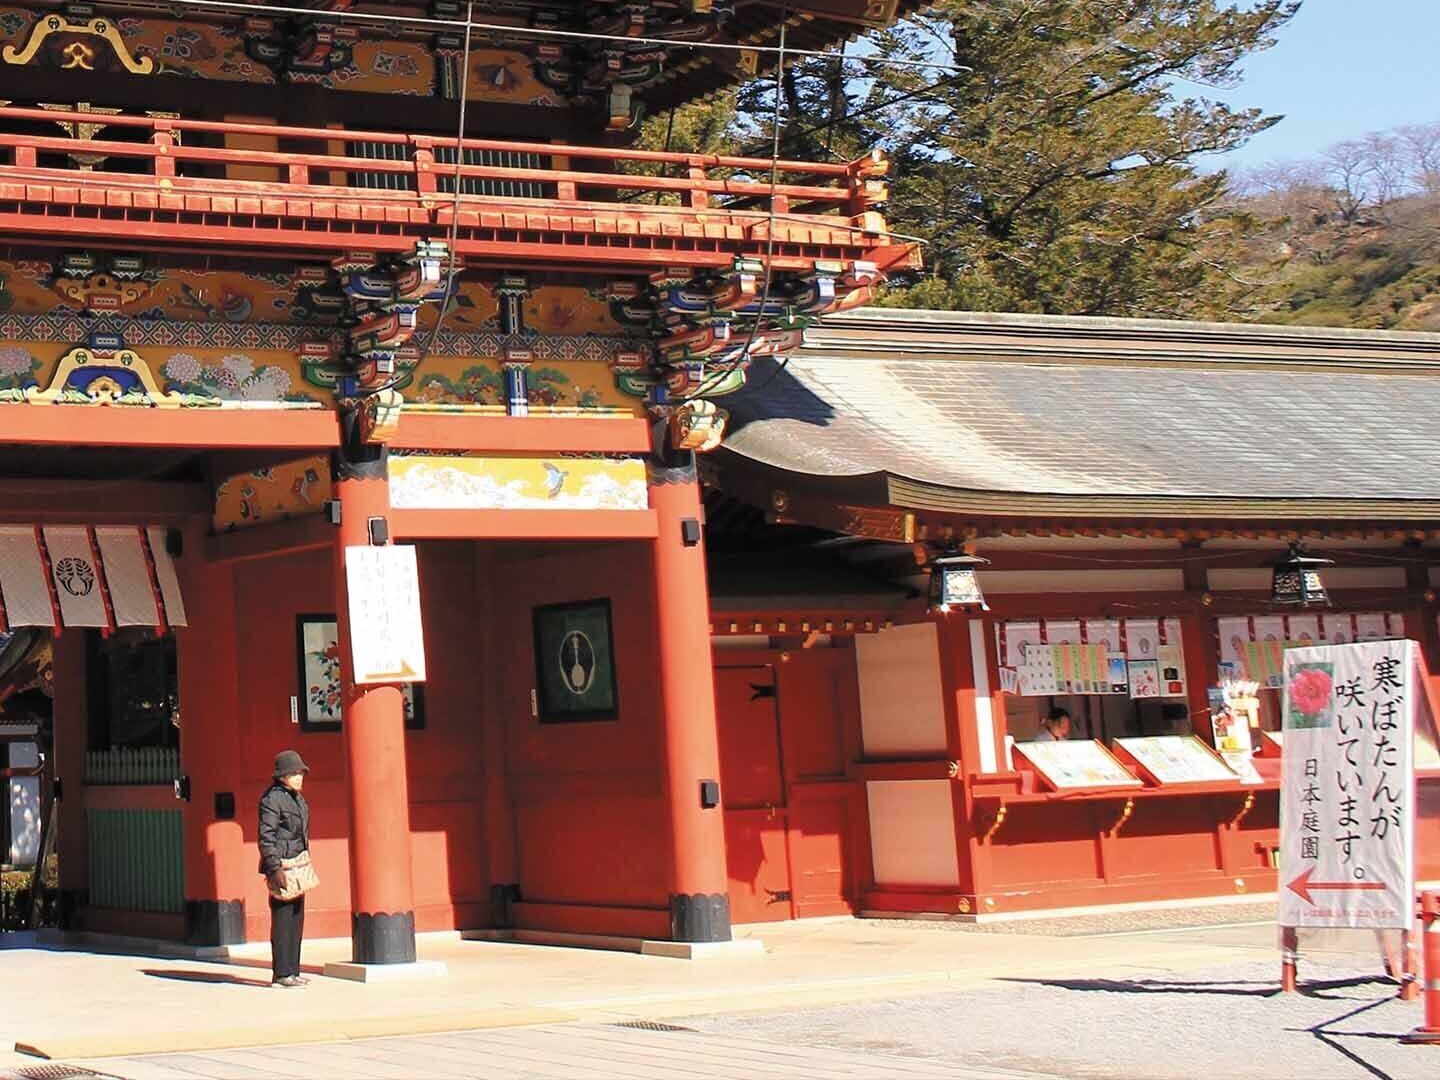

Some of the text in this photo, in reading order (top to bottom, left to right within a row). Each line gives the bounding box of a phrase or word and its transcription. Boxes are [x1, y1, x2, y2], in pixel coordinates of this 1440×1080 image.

[1301, 758, 1322, 859] 日本庭園
[1335, 678, 1367, 881] 咲いています。
[1370, 655, 1404, 842] 寒ぼたんが
